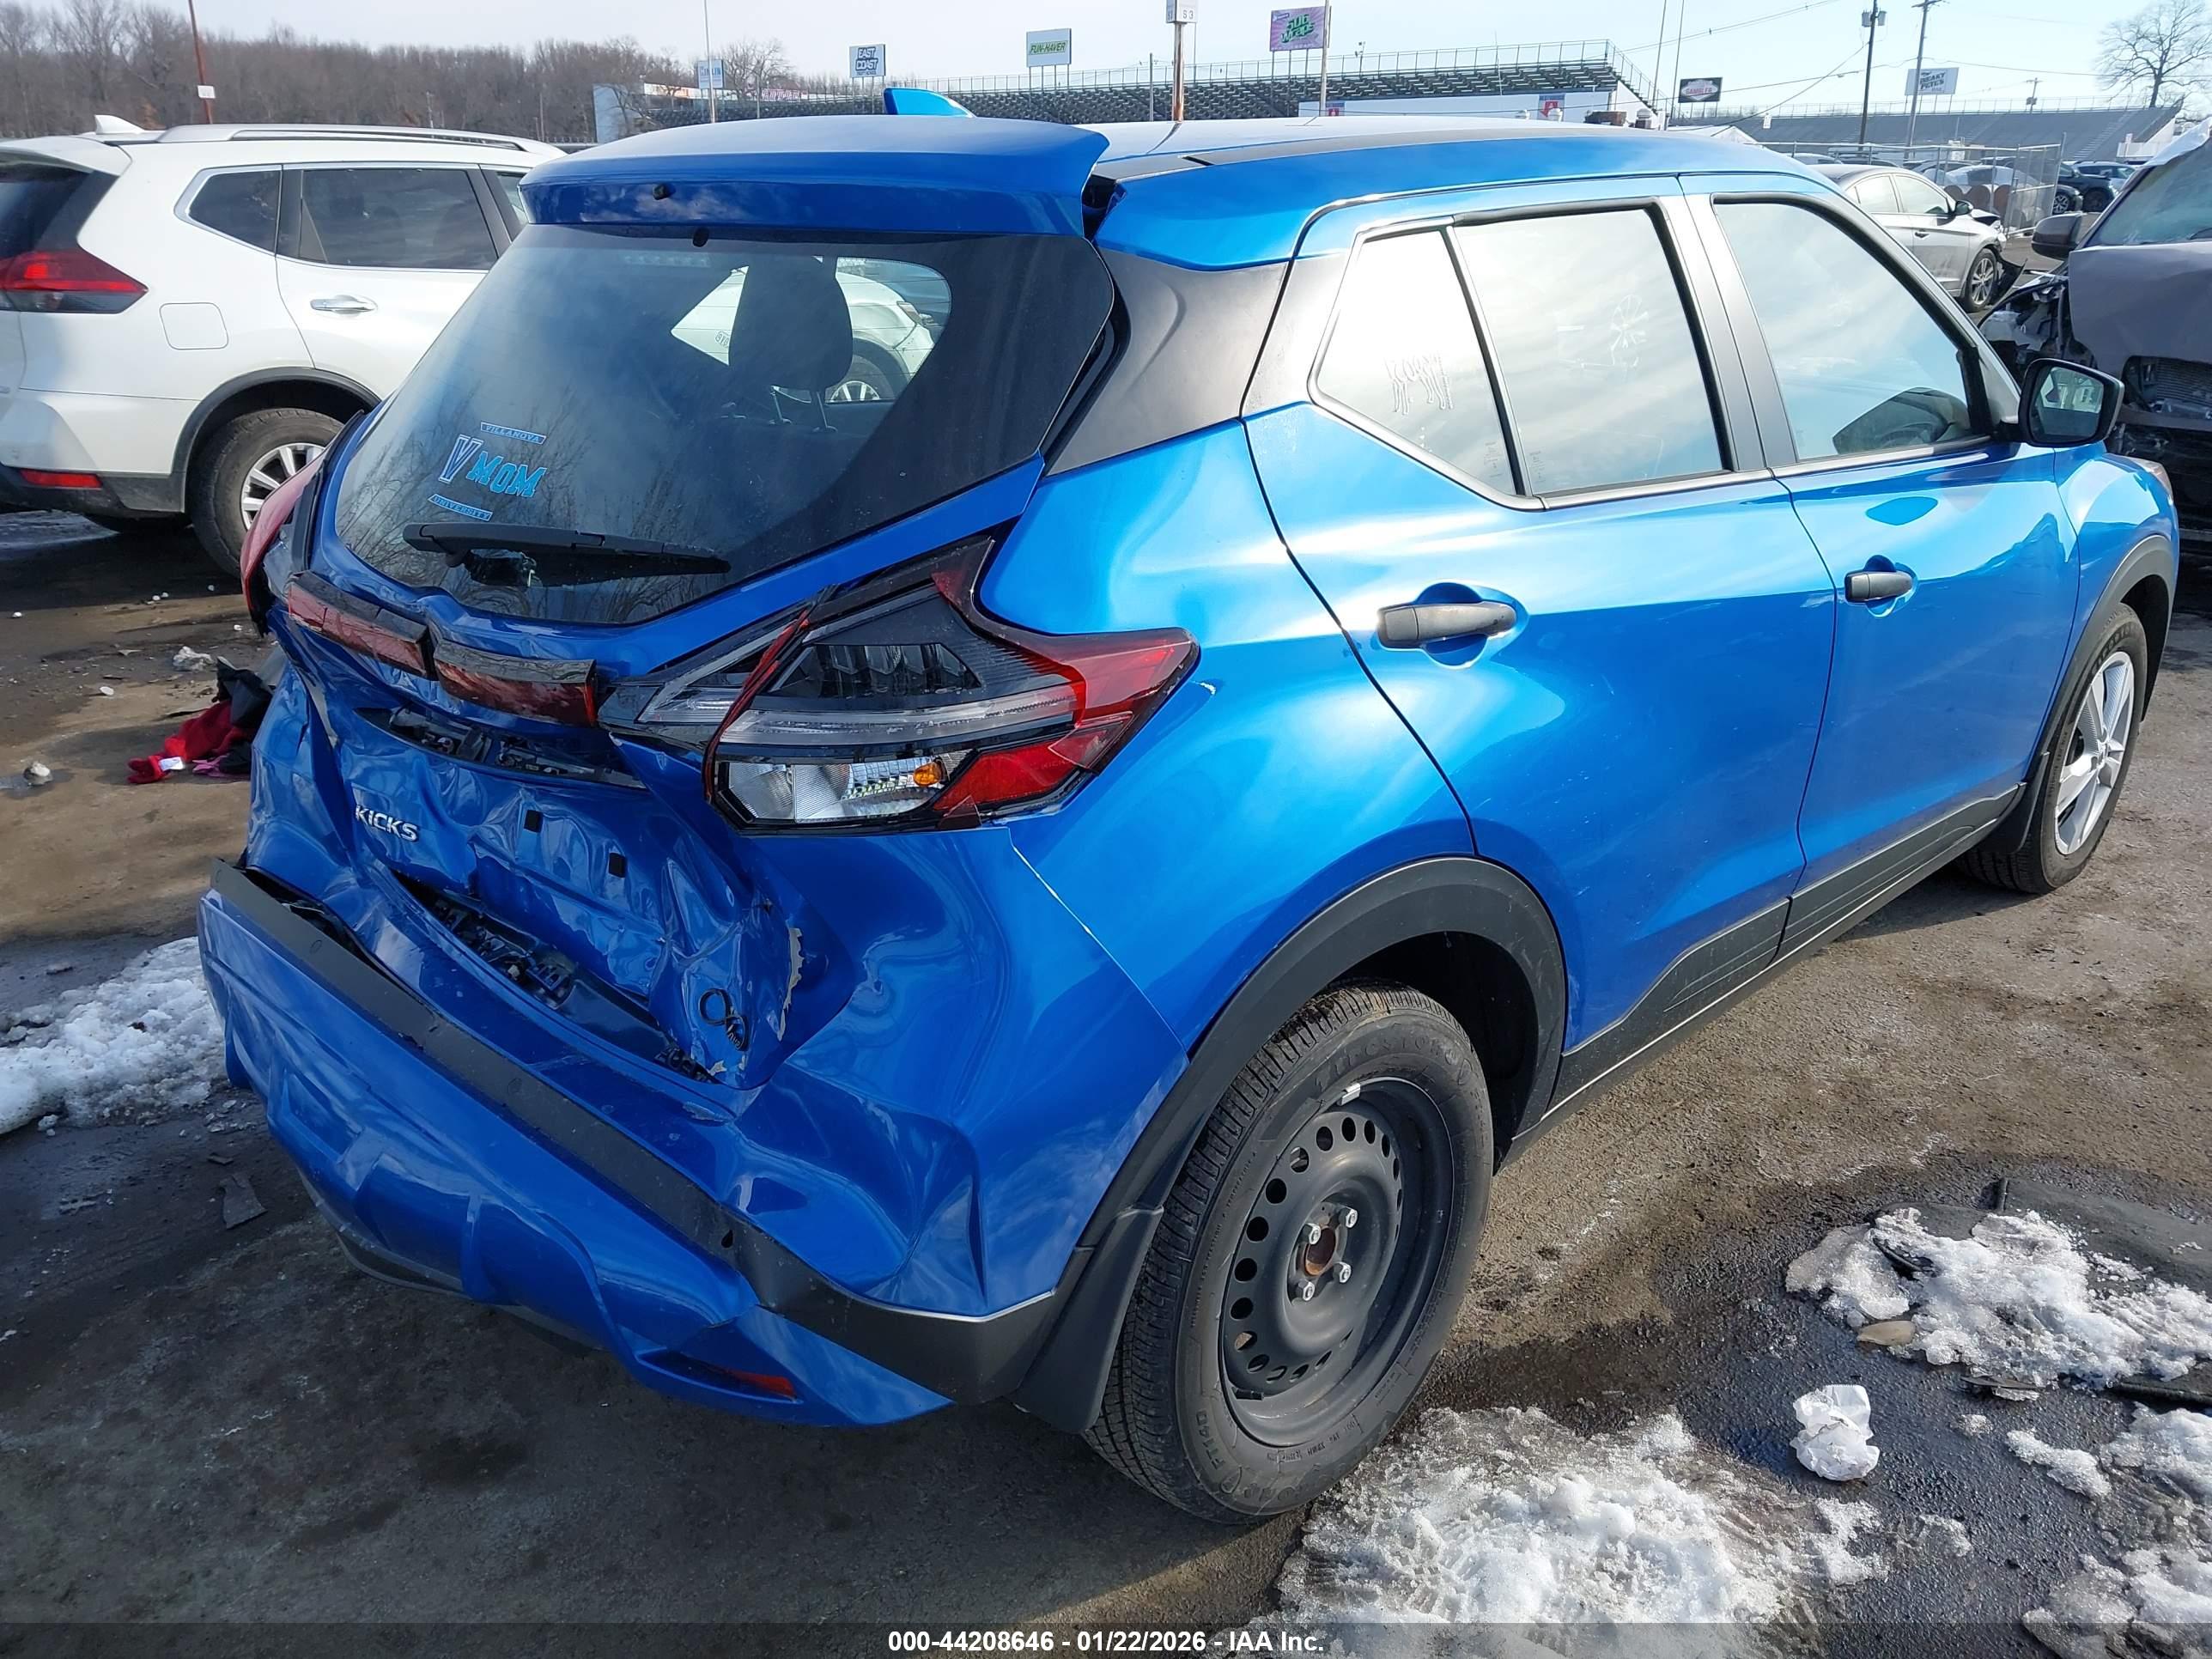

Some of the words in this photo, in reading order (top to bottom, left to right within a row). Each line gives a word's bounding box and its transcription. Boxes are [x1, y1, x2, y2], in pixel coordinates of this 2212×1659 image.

[858, 46, 876, 58] EAST
[855, 58, 878, 70] COAST
[486, 424, 540, 442] VILLANOVA
[438, 434, 483, 483] V
[466, 451, 547, 498] MOM
[434, 495, 490, 520] UNIVERSITY
[355, 805, 418, 842] KICKS
